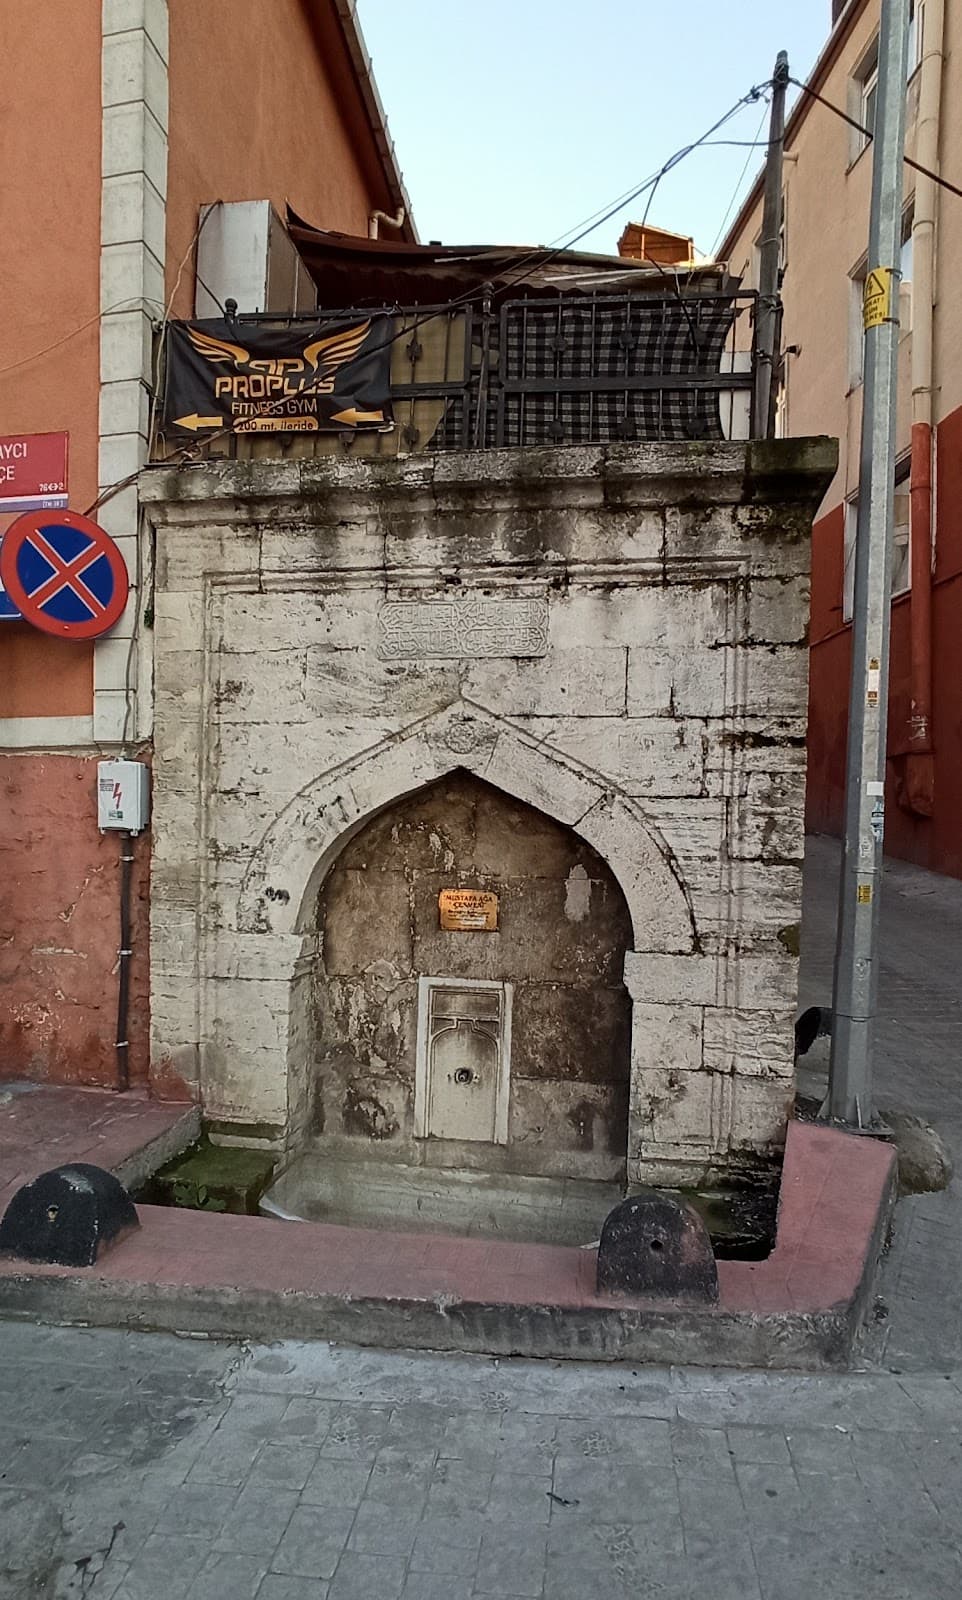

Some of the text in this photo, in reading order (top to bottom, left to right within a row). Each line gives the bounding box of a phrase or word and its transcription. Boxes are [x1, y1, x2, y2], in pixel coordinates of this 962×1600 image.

[215, 374, 336, 398] PROPLUS
[286, 398, 318, 414] GYM
[238, 420, 314, 432] 200 mt. ileride
